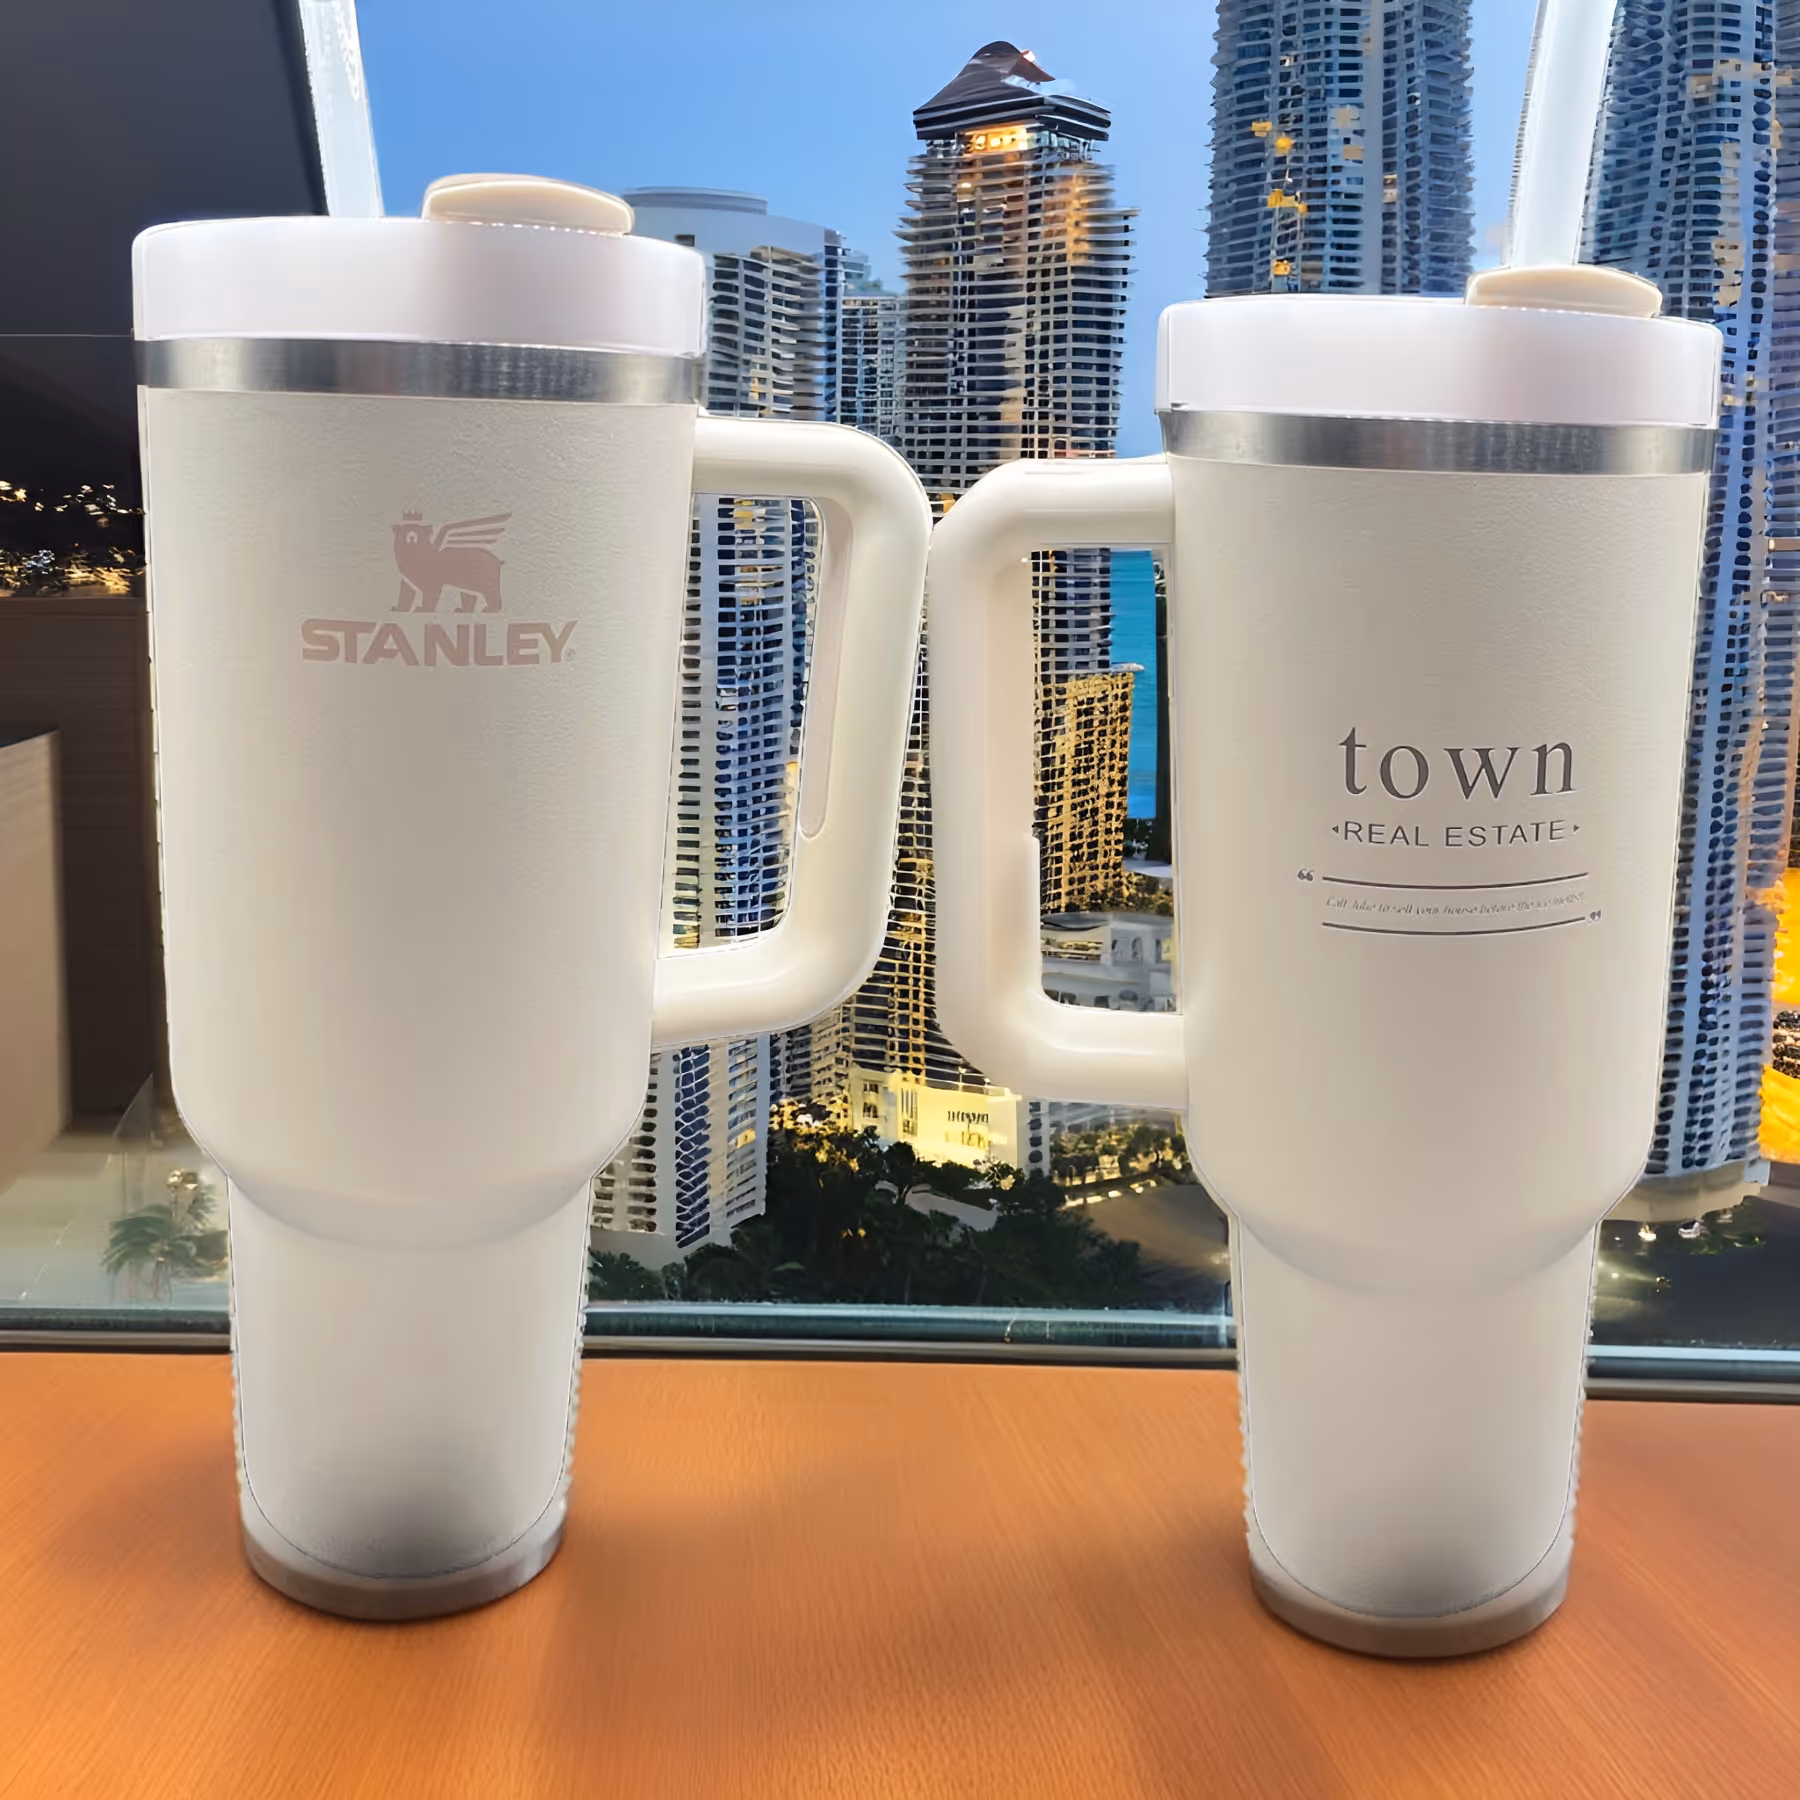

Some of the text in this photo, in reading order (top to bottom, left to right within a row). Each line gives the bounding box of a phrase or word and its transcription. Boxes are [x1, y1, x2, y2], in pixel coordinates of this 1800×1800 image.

[301, 618, 578, 667] STANLEY
[1338, 727, 1576, 800] town
[1344, 819, 1567, 847] REAL ESTATE
[1326, 896, 1348, 909] Call
[1378, 902, 1391, 913] to
